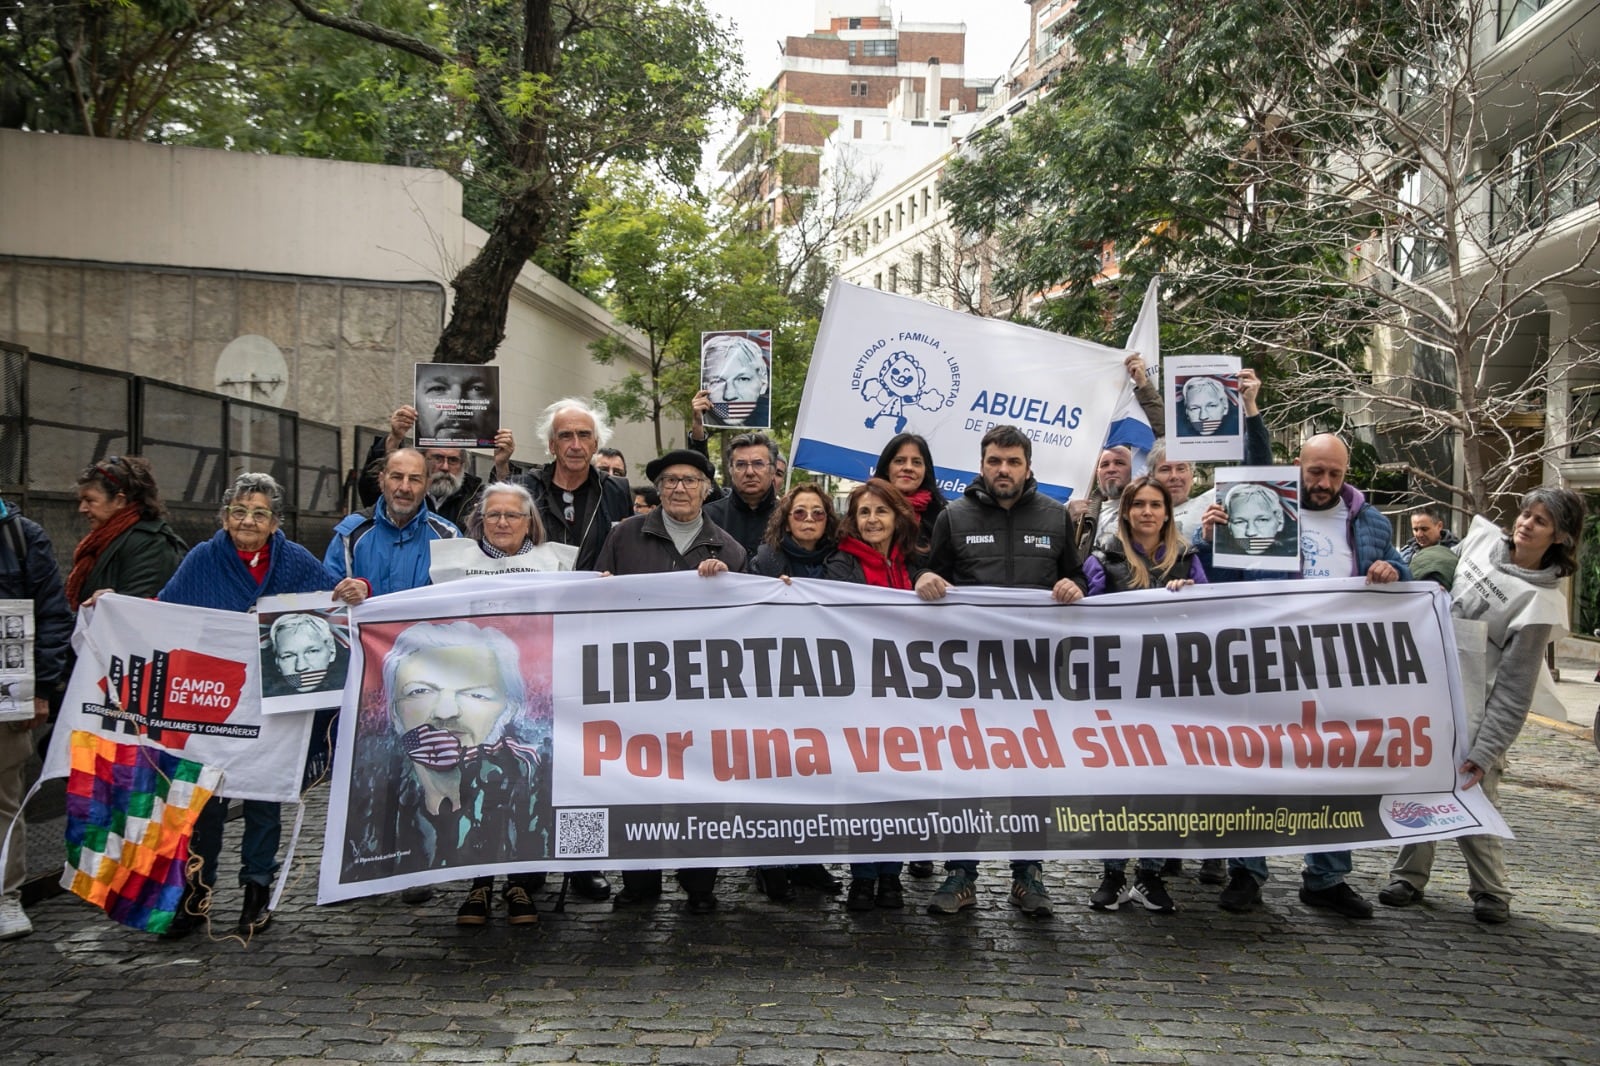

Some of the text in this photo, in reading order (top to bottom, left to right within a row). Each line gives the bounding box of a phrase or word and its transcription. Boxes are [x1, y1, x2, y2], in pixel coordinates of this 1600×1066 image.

[851, 332, 960, 408] IDENTIDAD FAMILIA LIBERTAD
[970, 390, 1083, 430] ABUELAS
[964, 418, 984, 433] DE
[1026, 428, 1042, 442] DE
[1042, 432, 1073, 448] MAYO
[966, 535, 995, 545] PRENSA
[1482, 576, 1509, 604] ASSANGE
[582, 621, 1428, 705] LIBERTAD ASSANGE ARGENTINA
[151, 654, 162, 713] JUSTICIA
[169, 691, 231, 709] DE MAYO
[171, 677, 225, 695] CAMPO
[150, 719, 196, 732] FAMILIARES
[199, 724, 204, 732] Y
[205, 725, 258, 737] COMPAÑERXS
[582, 700, 1433, 782] Por una verdad sin mordazas
[625, 806, 1364, 844] www.FreeAssangeEmergencyToolkit.com libertadassangeargentina@gmail.com
